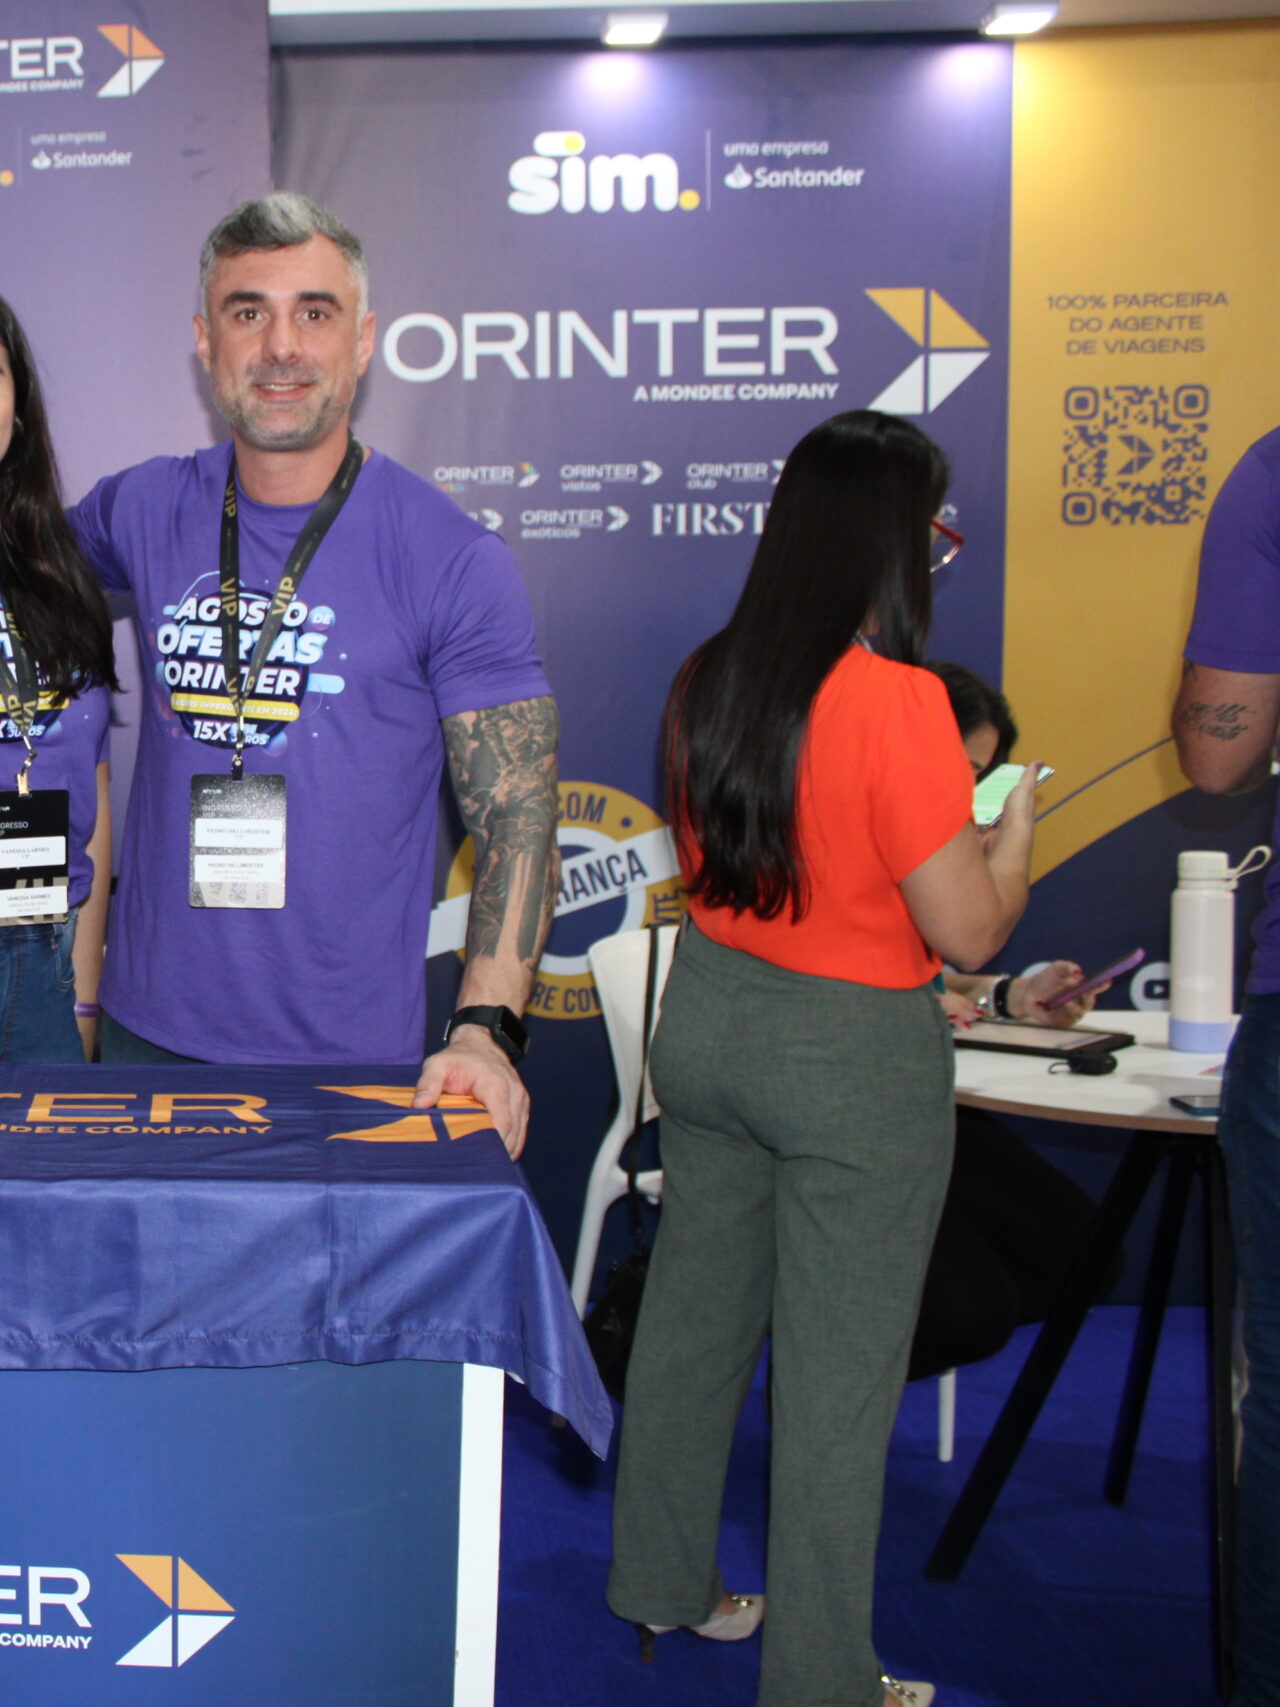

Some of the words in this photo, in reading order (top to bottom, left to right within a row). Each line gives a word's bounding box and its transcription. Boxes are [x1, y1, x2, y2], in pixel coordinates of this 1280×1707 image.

[29, 79, 84, 92] COMPANY
[31, 133, 56, 145] uma
[58, 131, 107, 145] empresa
[723, 142, 759, 157] uma
[761, 141, 829, 158] empresa
[52, 151, 133, 169] Santander
[754, 166, 865, 188] Santander
[1047, 294, 1107, 311] 100%
[1113, 292, 1229, 309] PARCEIRA
[1069, 316, 1102, 332] DO
[1108, 315, 1203, 332] AGENTE
[384, 307, 838, 382] ORINTER
[1066, 339, 1097, 355] DE
[1103, 338, 1205, 354] VIAGENS
[633, 385, 649, 402] A
[651, 384, 736, 402] MONDEE
[737, 382, 839, 400] COMPANY
[434, 466, 515, 483] ORINTER
[560, 463, 638, 480] ORINTER
[686, 462, 768, 479] ORINTER
[561, 481, 601, 491] vistos
[686, 477, 717, 489] club
[521, 509, 603, 526] ORINTER
[521, 525, 580, 538] exóticos
[221, 577, 236, 616] VIP
[271, 576, 295, 615] VIP
[173, 597, 308, 627] AGSO
[312, 614, 331, 625] DE
[157, 623, 328, 664] OFERAS
[193, 720, 229, 741] 15X
[231, 731, 269, 745] JROS
[85, 1125, 272, 1135] COMPANY
